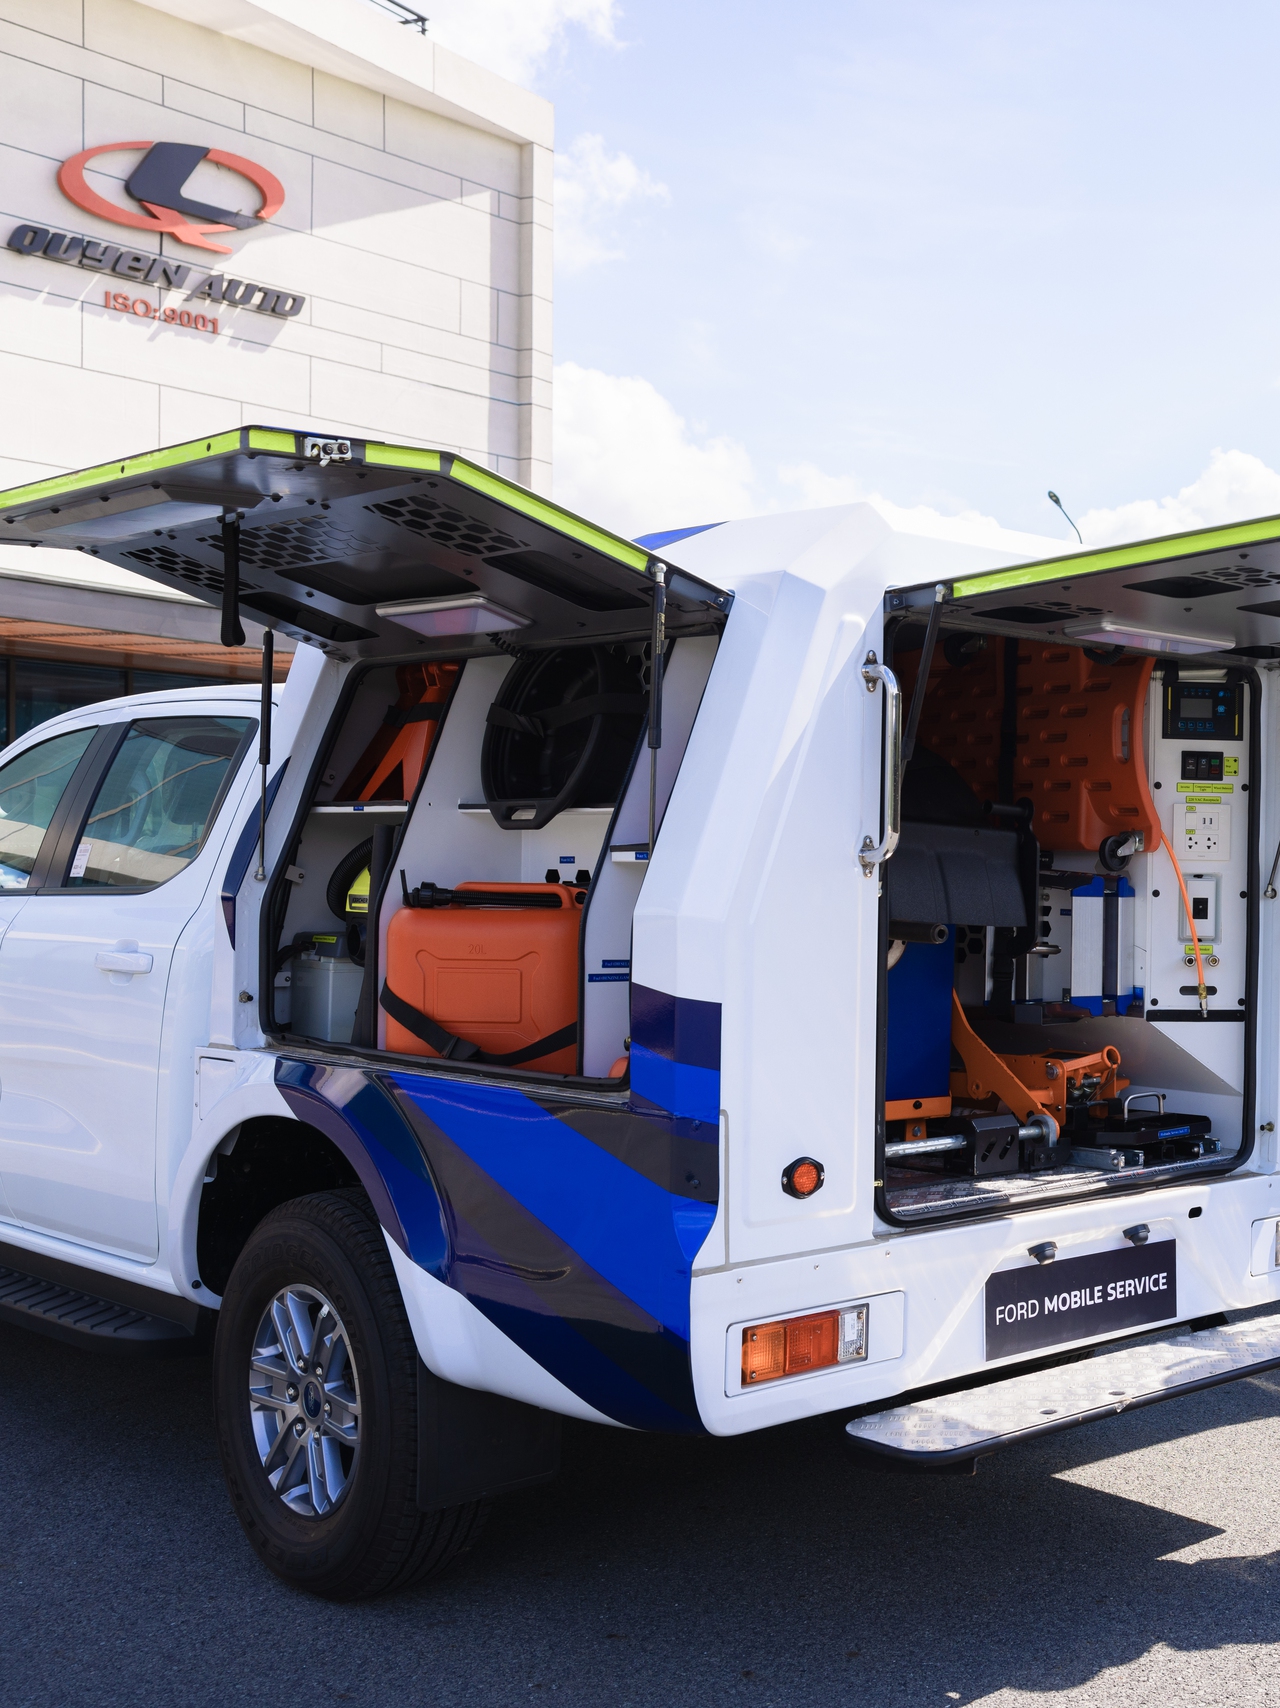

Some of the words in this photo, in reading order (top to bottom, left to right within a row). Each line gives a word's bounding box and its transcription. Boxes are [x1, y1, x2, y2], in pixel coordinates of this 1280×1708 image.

[183, 273, 306, 318] AUTO
[995, 1299, 1040, 1326] FORD
[1044, 1286, 1102, 1315] MOBILE
[1107, 1272, 1168, 1301] SERVICE
